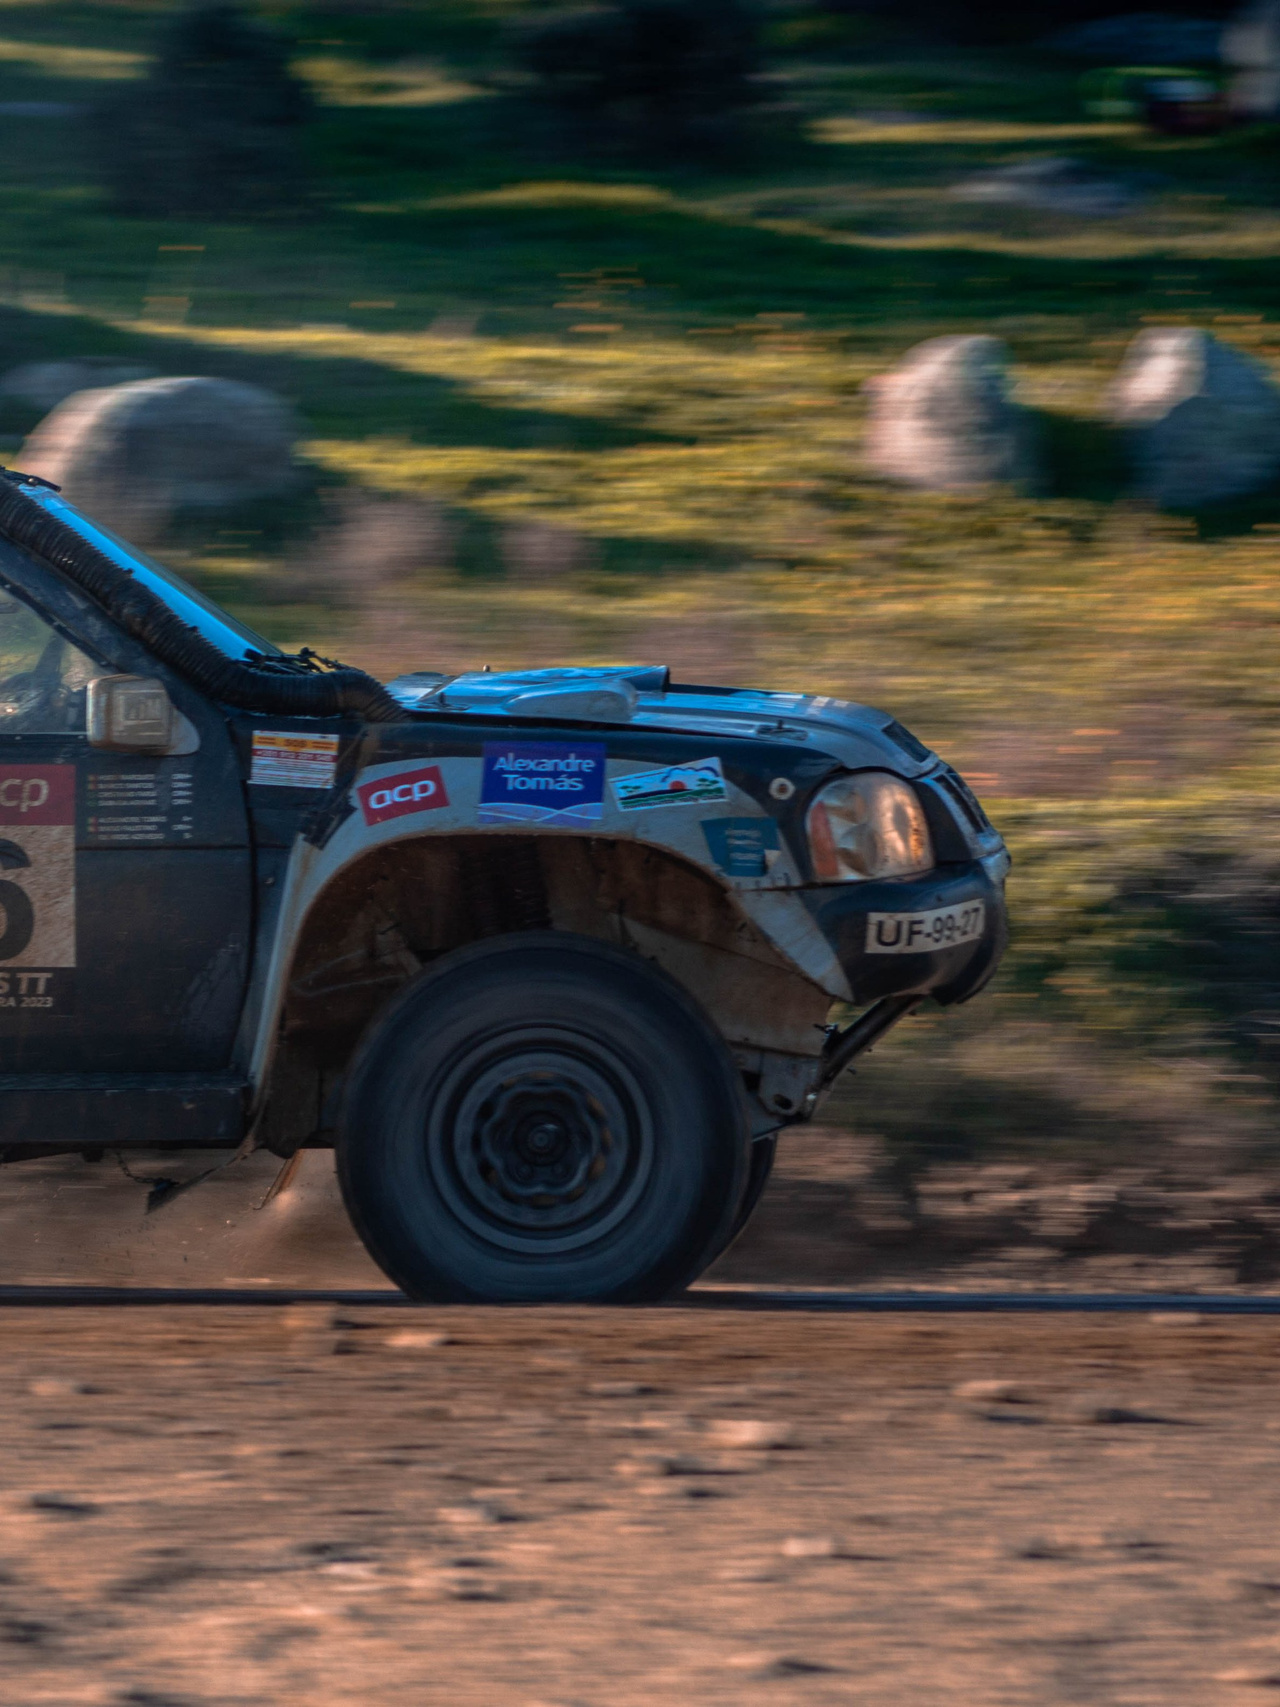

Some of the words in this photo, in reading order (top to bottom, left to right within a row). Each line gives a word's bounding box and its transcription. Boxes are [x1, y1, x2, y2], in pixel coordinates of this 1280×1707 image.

[491, 752, 596, 773] Alexandre
[503, 774, 584, 791] Tomás
[368, 778, 437, 810] acp
[876, 906, 981, 947] UF-99-27
[14, 971, 55, 995] TT
[19, 996, 55, 1008] 2023
